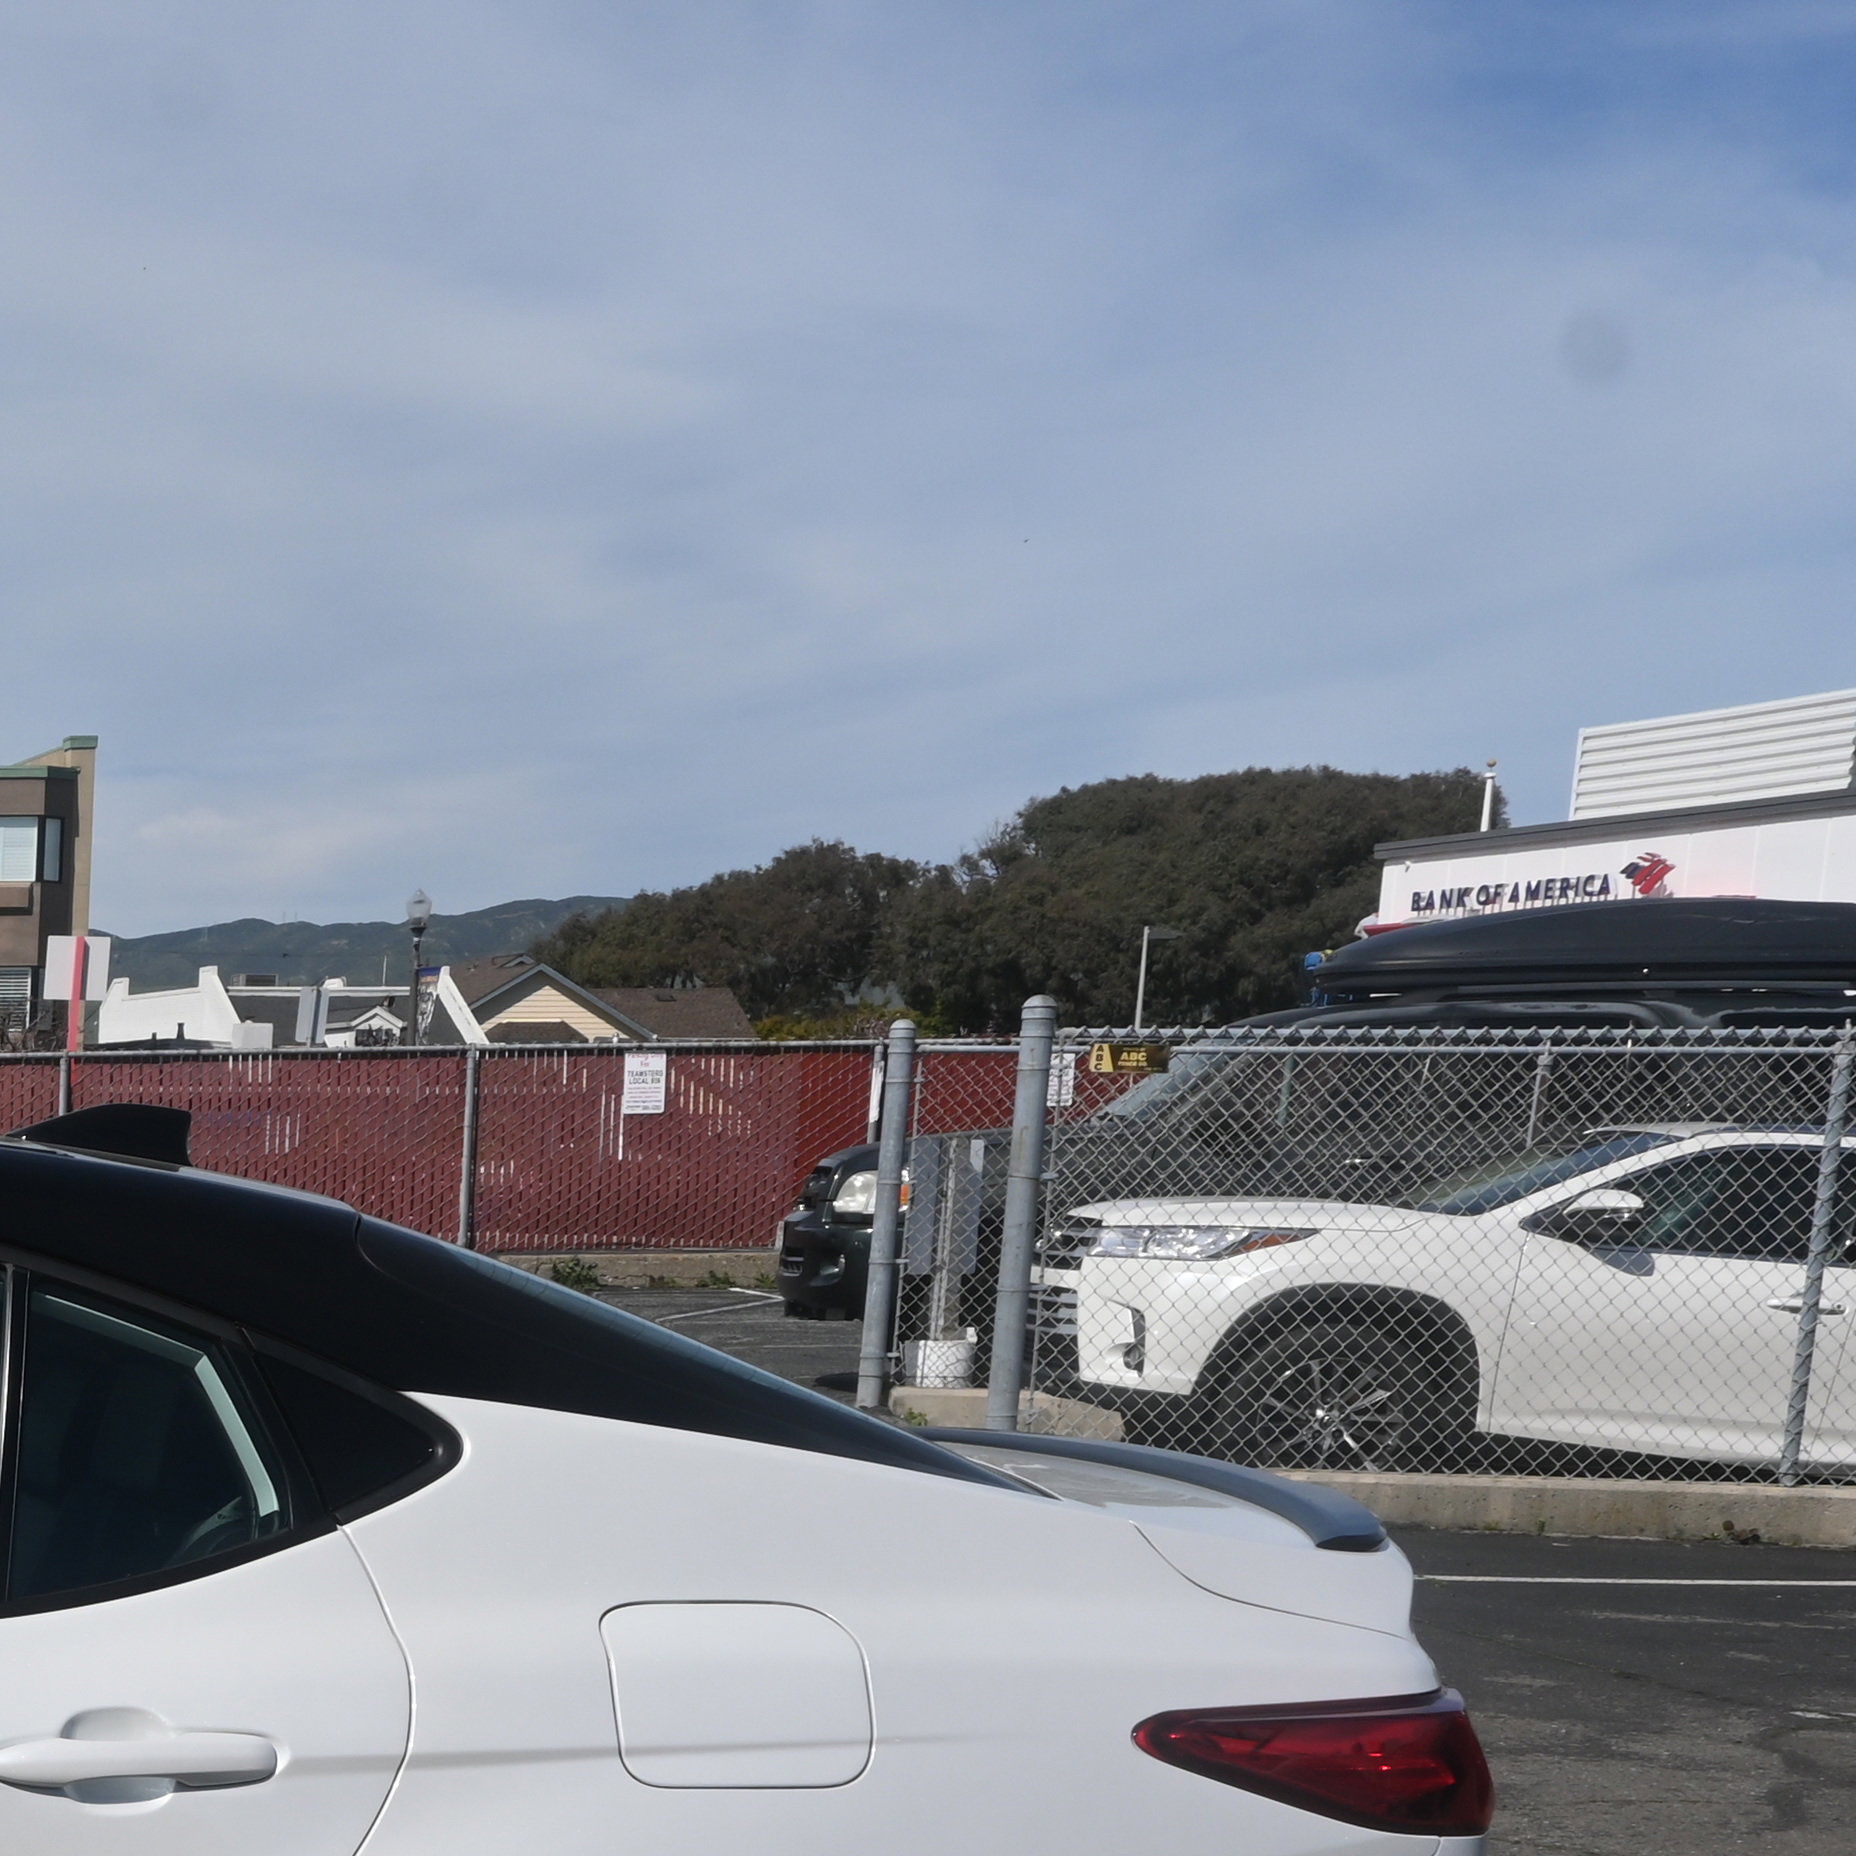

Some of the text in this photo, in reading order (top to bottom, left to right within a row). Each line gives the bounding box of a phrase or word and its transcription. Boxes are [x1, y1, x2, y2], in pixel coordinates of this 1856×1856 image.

[1411, 873, 1611, 912] BANK OF AMERICA
[1120, 1051, 1148, 1061] ABC
